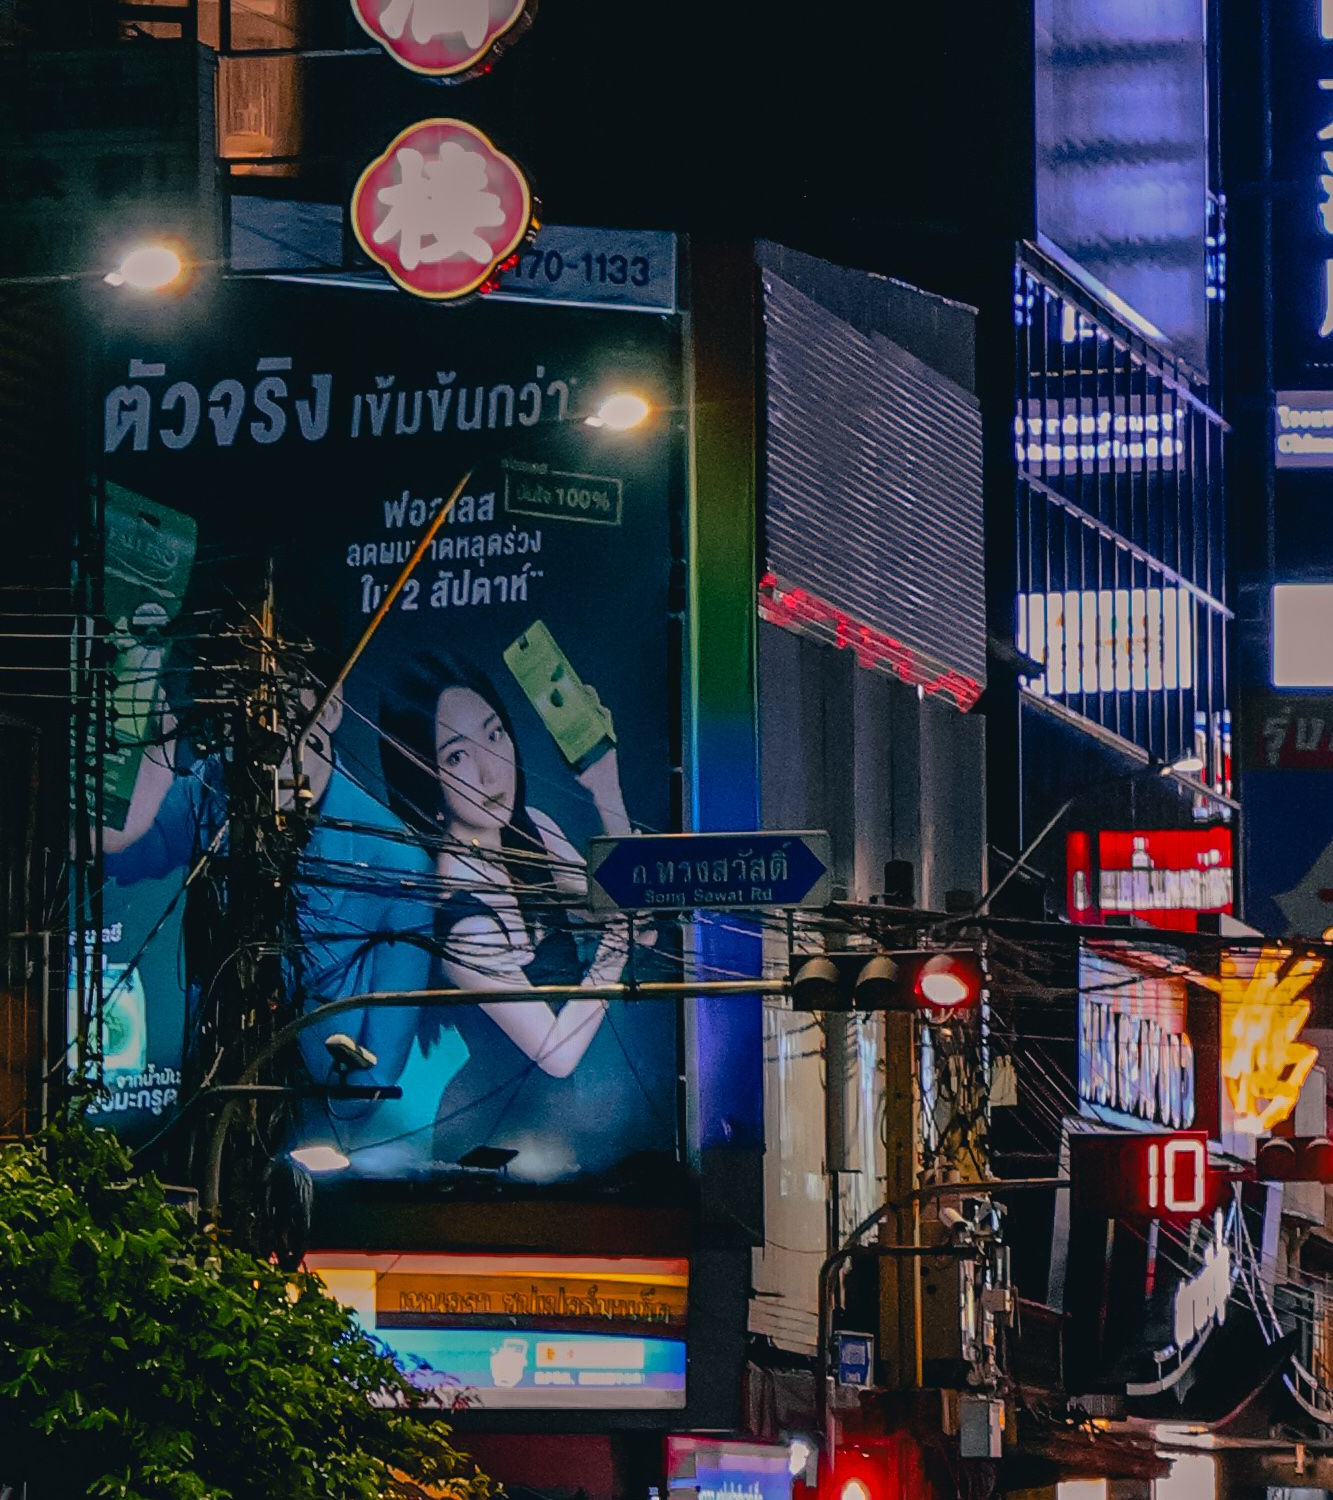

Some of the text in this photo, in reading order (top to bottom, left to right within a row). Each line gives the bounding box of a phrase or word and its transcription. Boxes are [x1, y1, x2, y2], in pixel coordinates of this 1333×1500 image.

[104, 357, 333, 453] ตัวจริง
[400, 579, 420, 611] 2
[751, 887, 774, 902] Rd
